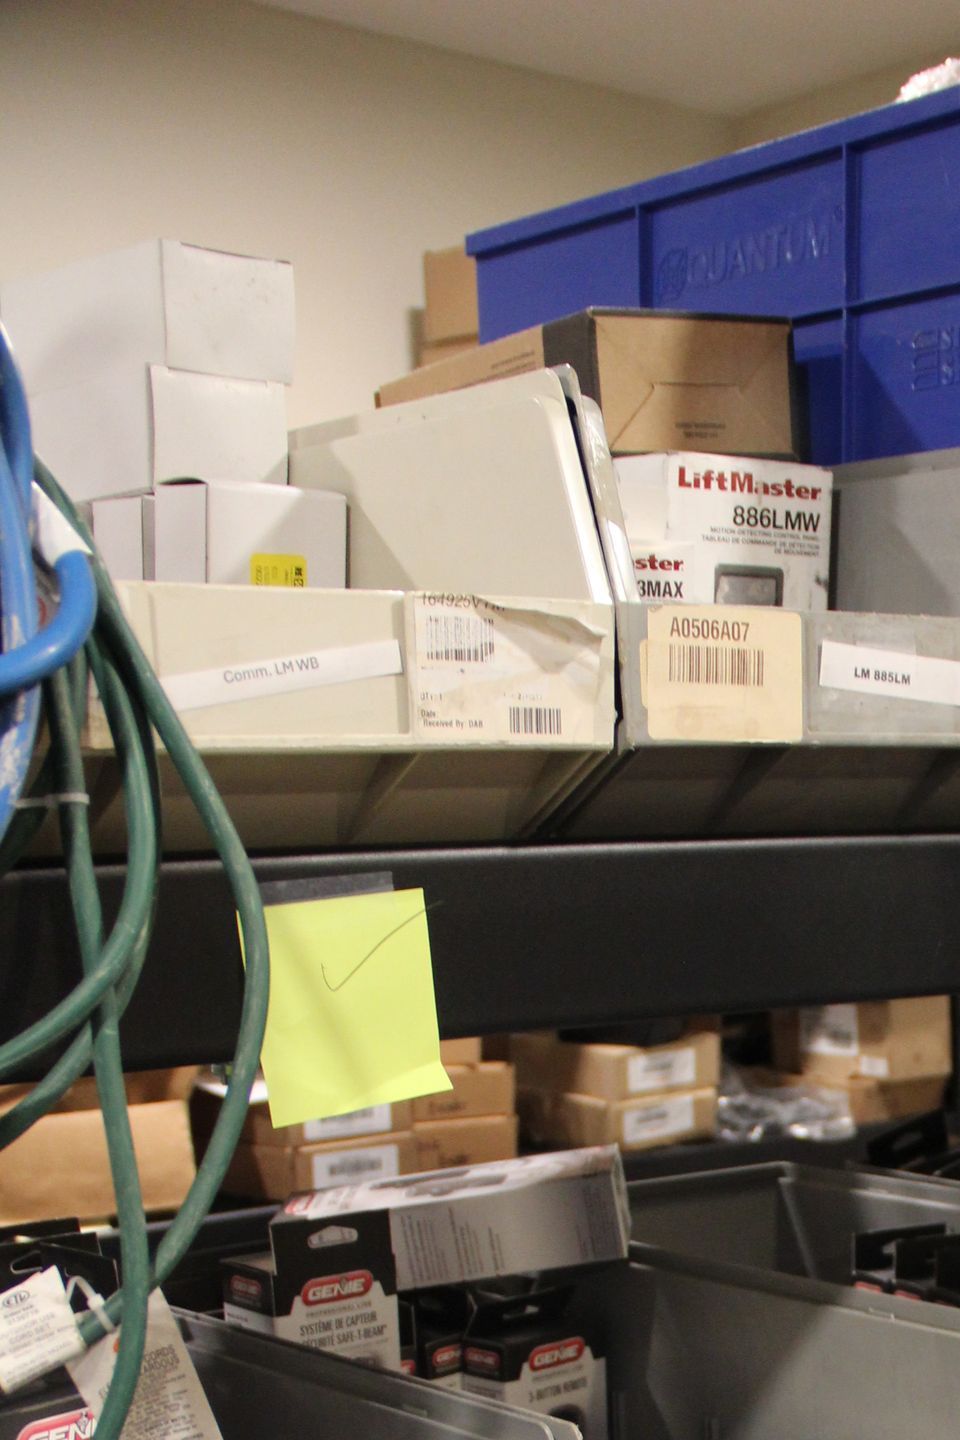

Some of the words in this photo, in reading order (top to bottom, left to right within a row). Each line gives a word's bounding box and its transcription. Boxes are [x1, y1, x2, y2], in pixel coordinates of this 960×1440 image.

[687, 216, 832, 286] QUANTUM
[678, 466, 822, 500] LiftMaster
[733, 505, 820, 532] 886LMW
[638, 579, 684, 598] 3MAX
[670, 616, 750, 642] A0506A07
[223, 666, 272, 684] Comm.
[275, 660, 295, 676] LM
[296, 656, 320, 672] WB
[854, 666, 870, 680] LM
[874, 669, 911, 685] 885LM
[308, 1278, 366, 1302] GENIE
[345, 1311, 377, 1326] CAPTEUR
[534, 1344, 580, 1367] GENIE
